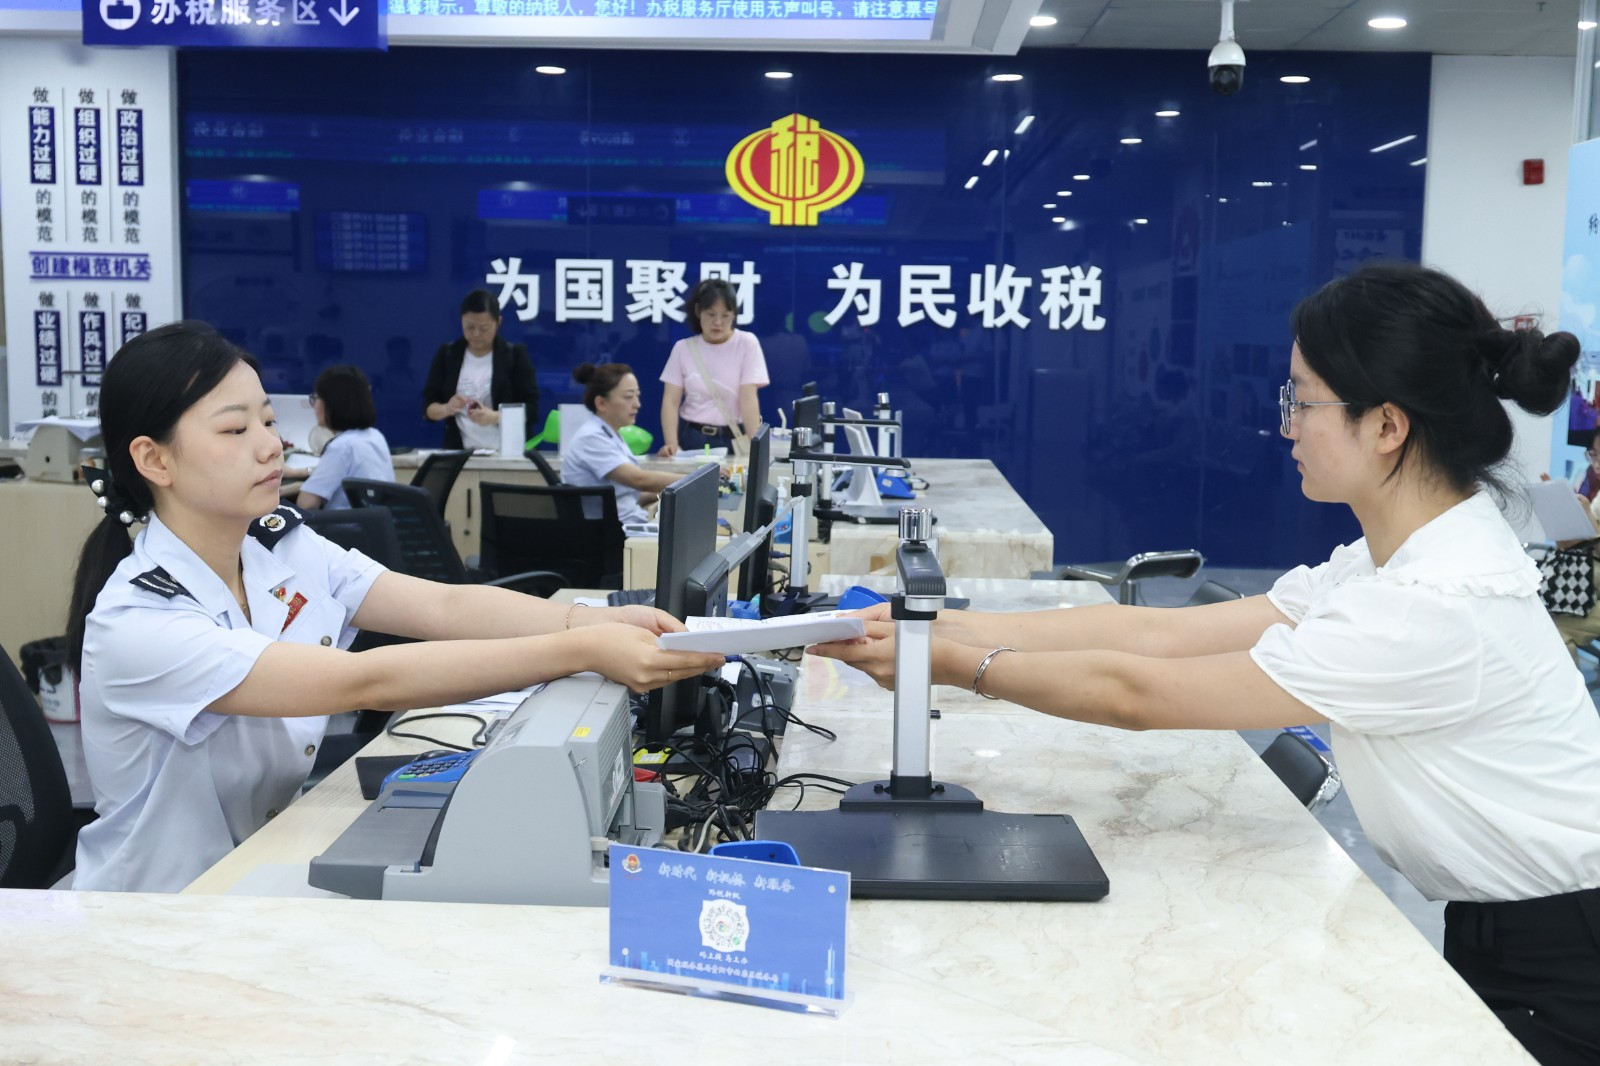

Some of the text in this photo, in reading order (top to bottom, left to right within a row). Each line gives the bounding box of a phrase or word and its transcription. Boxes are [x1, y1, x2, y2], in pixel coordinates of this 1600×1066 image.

[150, 0, 321, 25] 办税服务区
[32, 256, 151, 278] 创建模范机关
[486, 257, 1107, 332] 为国聚财 为民收税
[658, 861, 697, 881] 新时代
